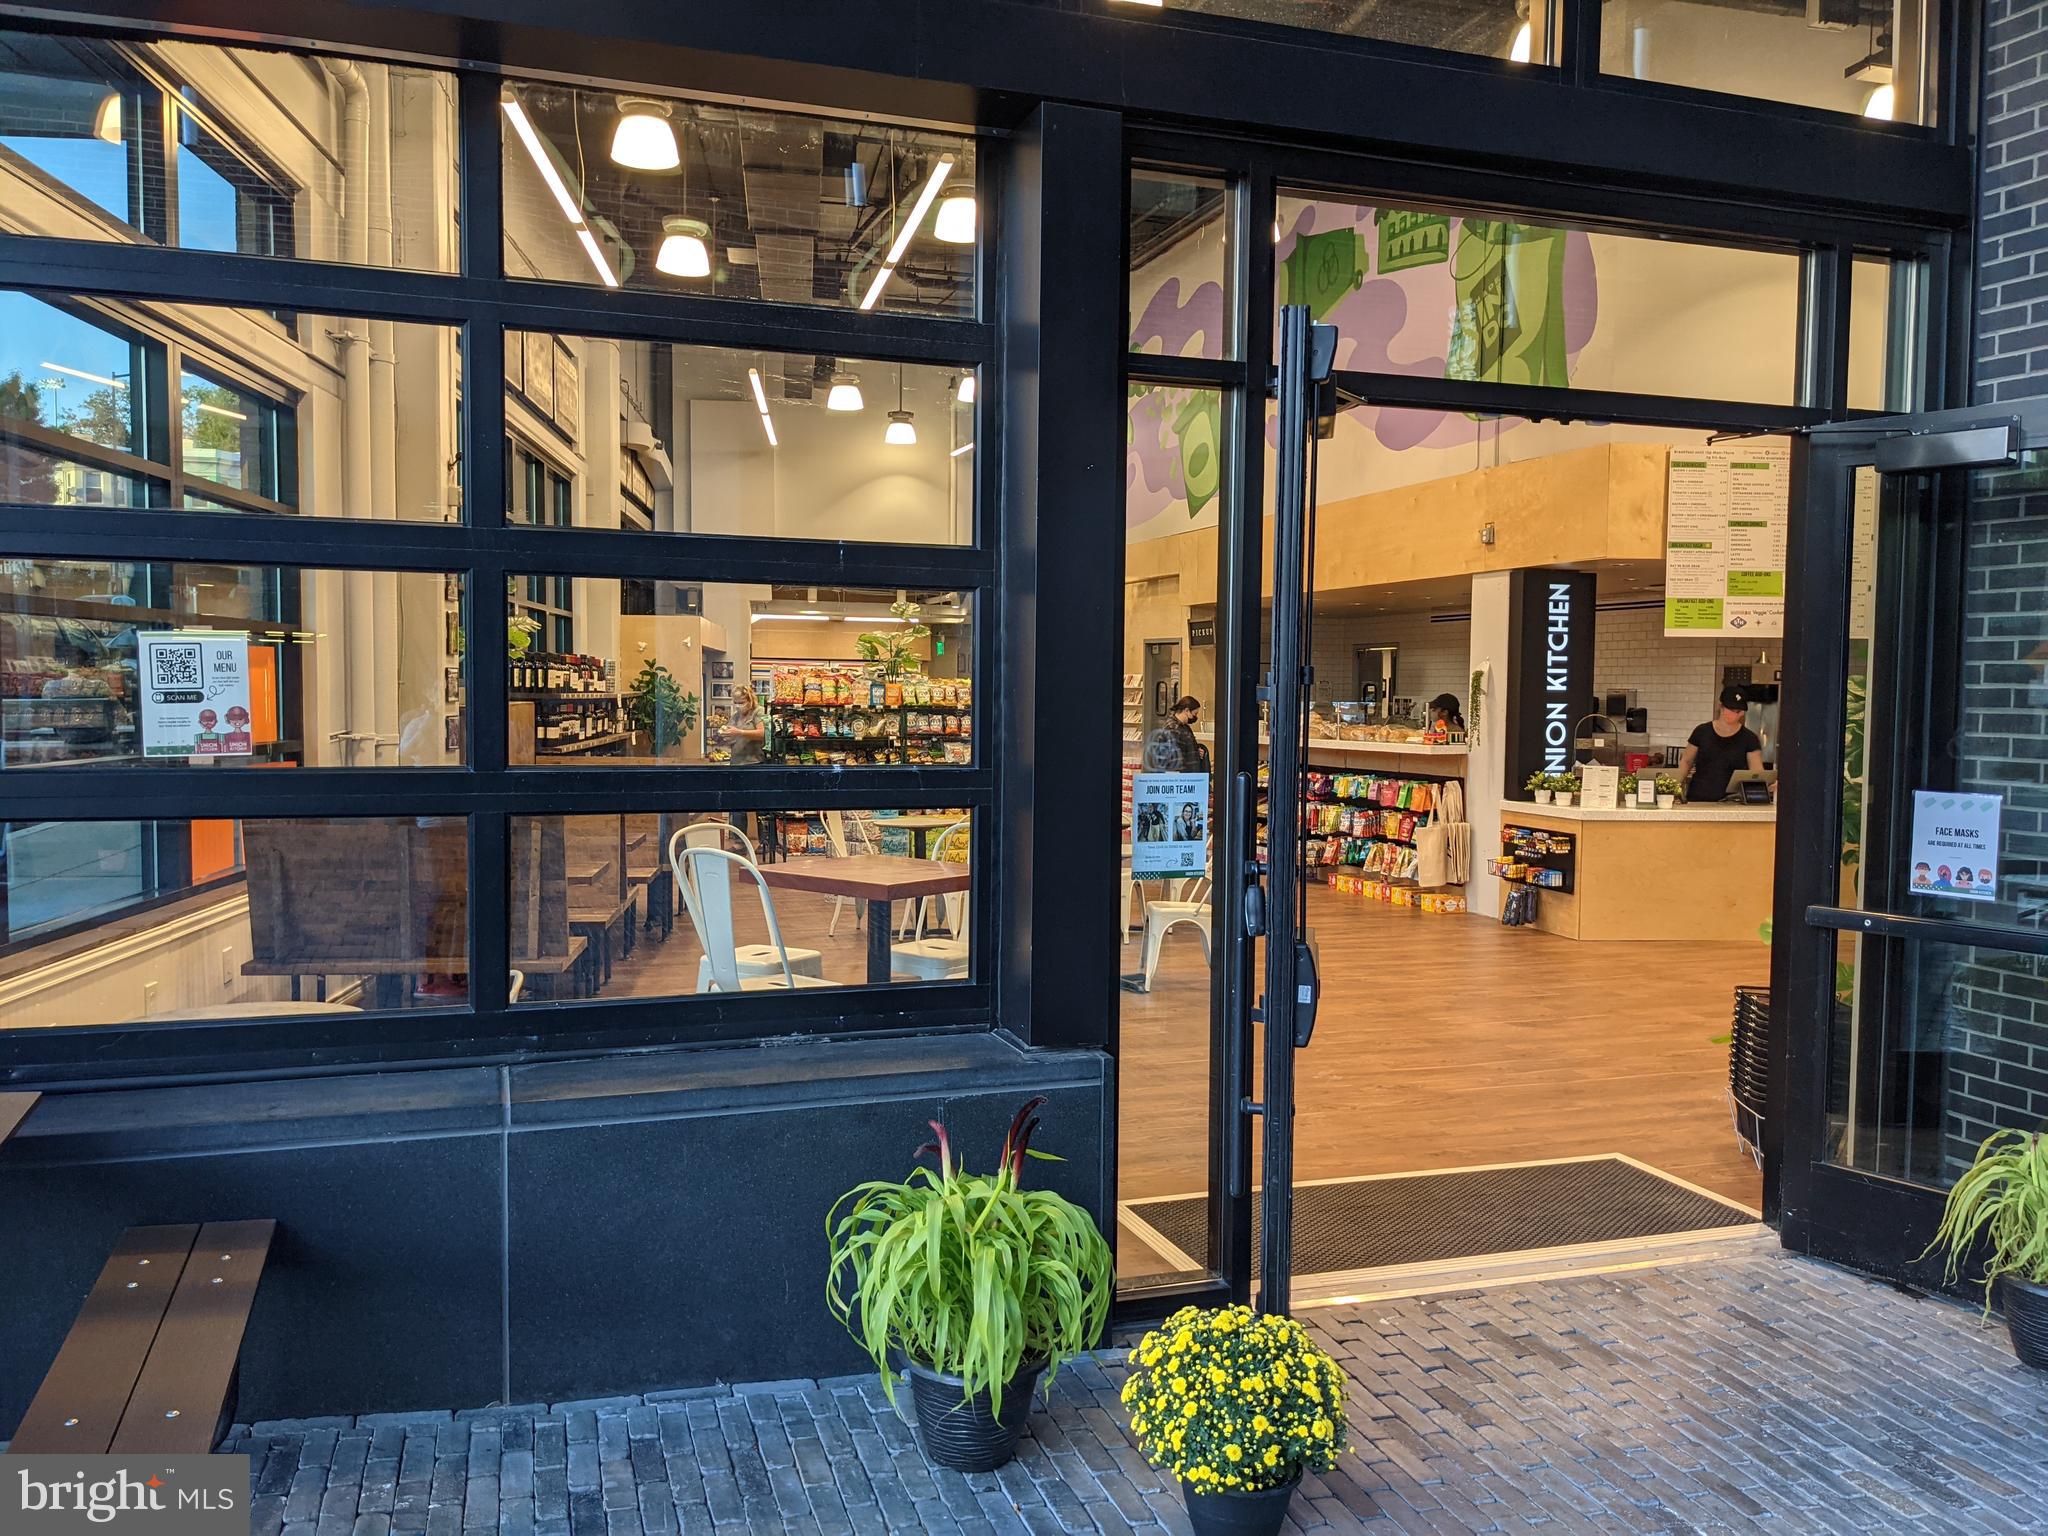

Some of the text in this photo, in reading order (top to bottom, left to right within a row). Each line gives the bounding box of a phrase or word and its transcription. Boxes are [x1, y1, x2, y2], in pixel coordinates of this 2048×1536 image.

[216, 650, 233, 660] OUR
[213, 662, 237, 673] MENU
[1544, 583, 1571, 778] NION KITCHEN
[1146, 784, 1196, 795] JOIN OUR TEAM!
[1935, 827, 1979, 838] FACE MASKS
